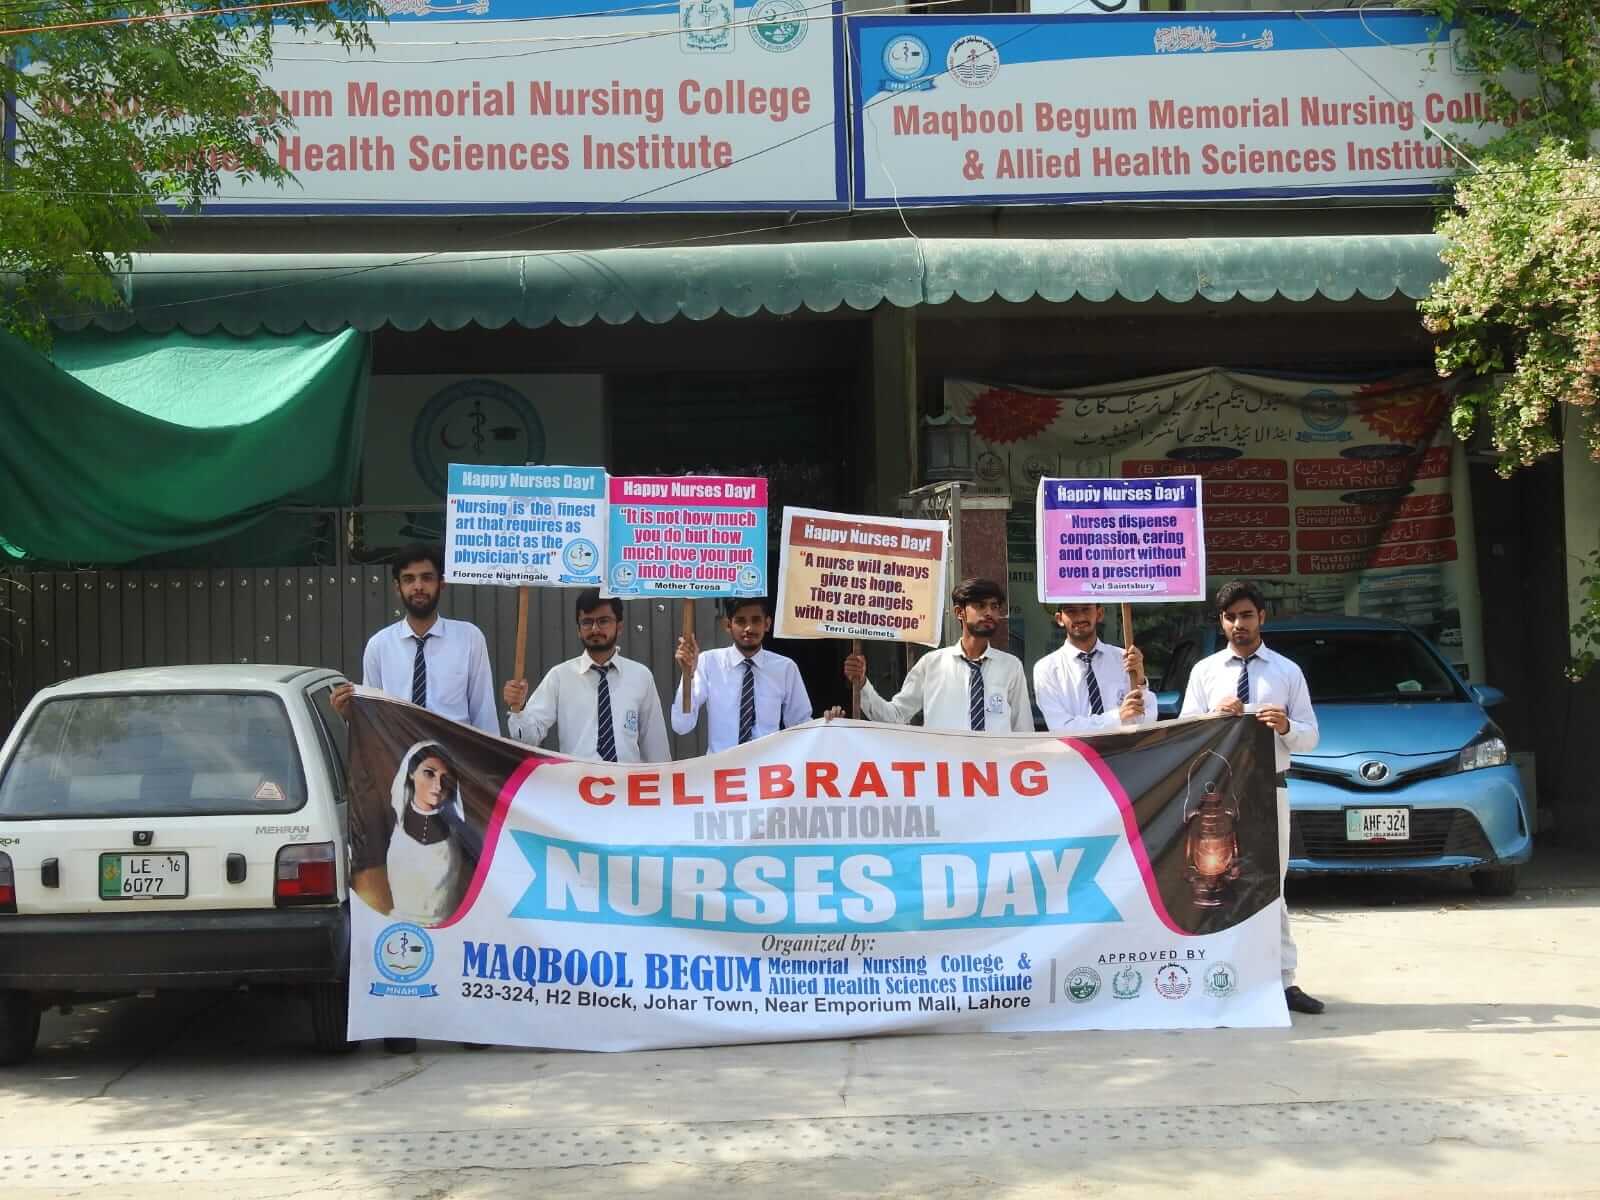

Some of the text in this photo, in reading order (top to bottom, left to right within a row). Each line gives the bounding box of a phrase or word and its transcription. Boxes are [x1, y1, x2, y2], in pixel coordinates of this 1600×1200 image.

[347, 81, 515, 117] Memorial
[530, 80, 664, 123] Nursing
[679, 79, 811, 122] College
[893, 103, 1023, 141] Maqbool
[1035, 102, 1137, 138] Begum
[1148, 97, 1289, 130] Memorial
[1301, 95, 1414, 131] Nursing
[278, 136, 395, 171] Health
[408, 135, 570, 171] Sciences
[583, 134, 733, 169] Institute
[962, 150, 984, 180] &
[996, 148, 1081, 179] Allied
[1092, 146, 1191, 177] Health
[1201, 144, 1336, 176] Sciences
[462, 471, 595, 491] Happy Nurses Day!
[623, 481, 756, 500] Happy Nurses Day!
[1057, 486, 1185, 502] Happy Nurses Day!
[513, 501, 524, 515] is
[531, 501, 551, 515] the
[558, 502, 596, 517] finest
[640, 508, 653, 524] is
[656, 509, 680, 525] not
[682, 509, 713, 525] how
[715, 511, 757, 527] much
[456, 517, 581, 535] art that requires as
[1119, 514, 1177, 530] dispense
[455, 533, 563, 549] much tact as the
[634, 528, 742, 545] you do but how
[804, 524, 931, 552] Happy Nurses Day!
[1060, 530, 1184, 546] compassion, caring
[623, 545, 753, 564] much love you put
[1059, 546, 1186, 560] and comfort without
[453, 570, 493, 580] Florence
[496, 571, 549, 582] Nightingale
[638, 563, 665, 579] into
[669, 564, 692, 579] the
[816, 556, 855, 571] nurse
[858, 558, 881, 573] will
[883, 562, 929, 579] always
[1059, 566, 1088, 578] even
[1092, 566, 1099, 578] a
[655, 582, 721, 591] Mother Teresa
[820, 572, 905, 594] give us hope.
[1107, 582, 1155, 591] Saintsbury
[811, 587, 913, 611] They are angels
[795, 605, 823, 620] with
[826, 609, 834, 622] a
[824, 625, 845, 633] Terri
[578, 760, 1049, 807] CELEBRATING
[255, 825, 310, 835] MEHRAN
[693, 804, 941, 840] INTERNATIONAL
[130, 859, 152, 874] LE
[124, 877, 164, 893] 6077
[545, 846, 1085, 925] NURSES DAY
[761, 934, 876, 956] Organized by:
[768, 952, 1032, 976] Memorial Nursing College &
[1099, 949, 1206, 963] APPROVED BY
[462, 940, 762, 992] MAQBOOL BEGUM
[769, 973, 1033, 995] Allied Health Sciences Institute
[461, 982, 1031, 1016] 323-324, H2 Block, Johar Town, Near Emporium Mall, Lahore
